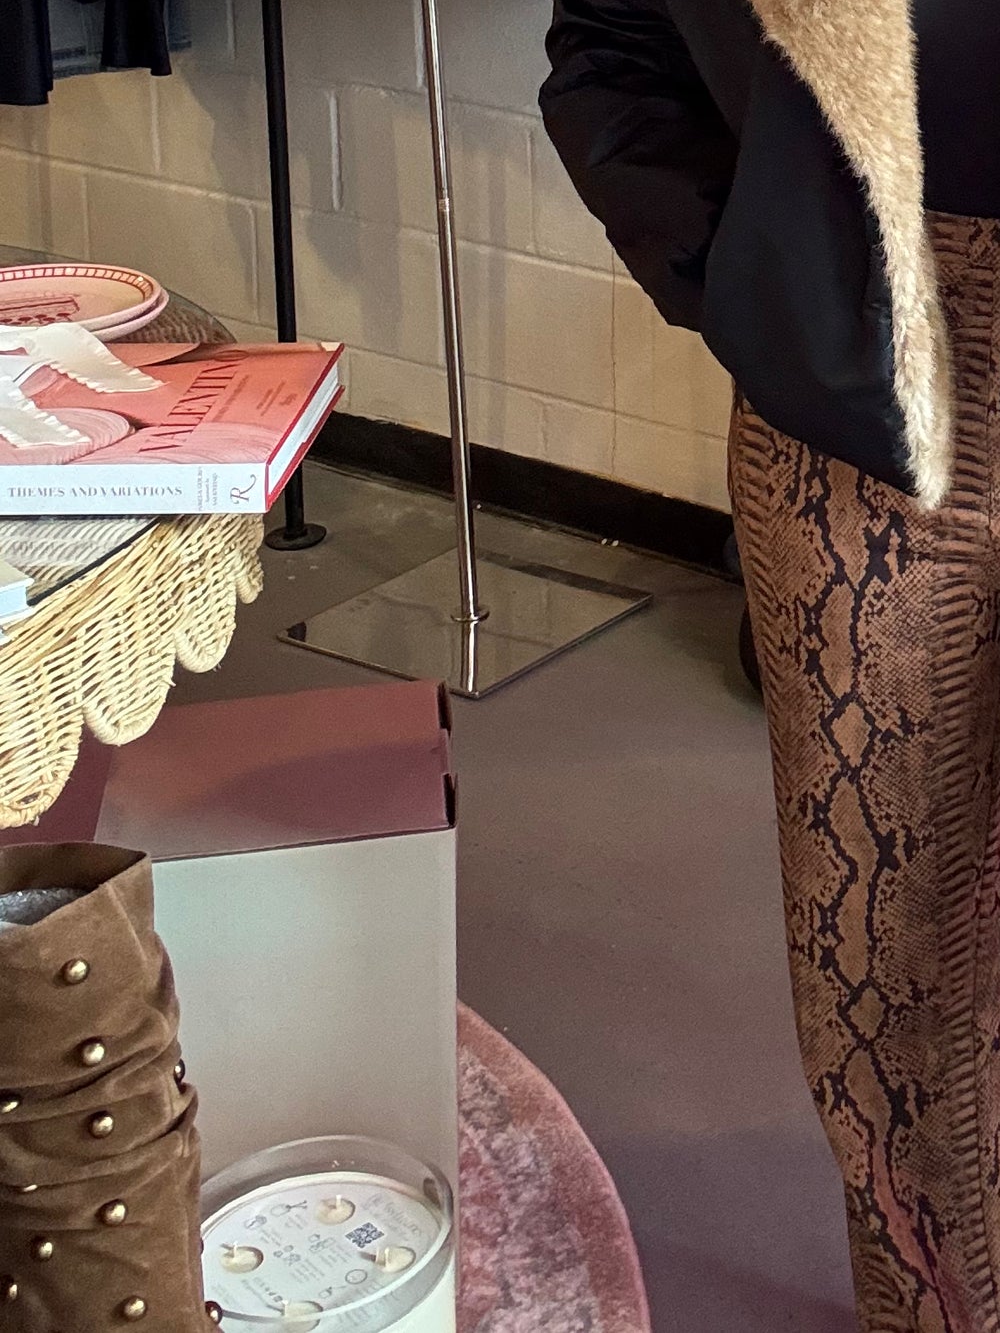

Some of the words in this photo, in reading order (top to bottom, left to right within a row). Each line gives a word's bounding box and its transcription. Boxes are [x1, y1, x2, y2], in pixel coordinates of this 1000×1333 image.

[7, 487, 66, 498] THEMES
[71, 487, 98, 498] AND
[99, 486, 183, 497] VARIATIONS
